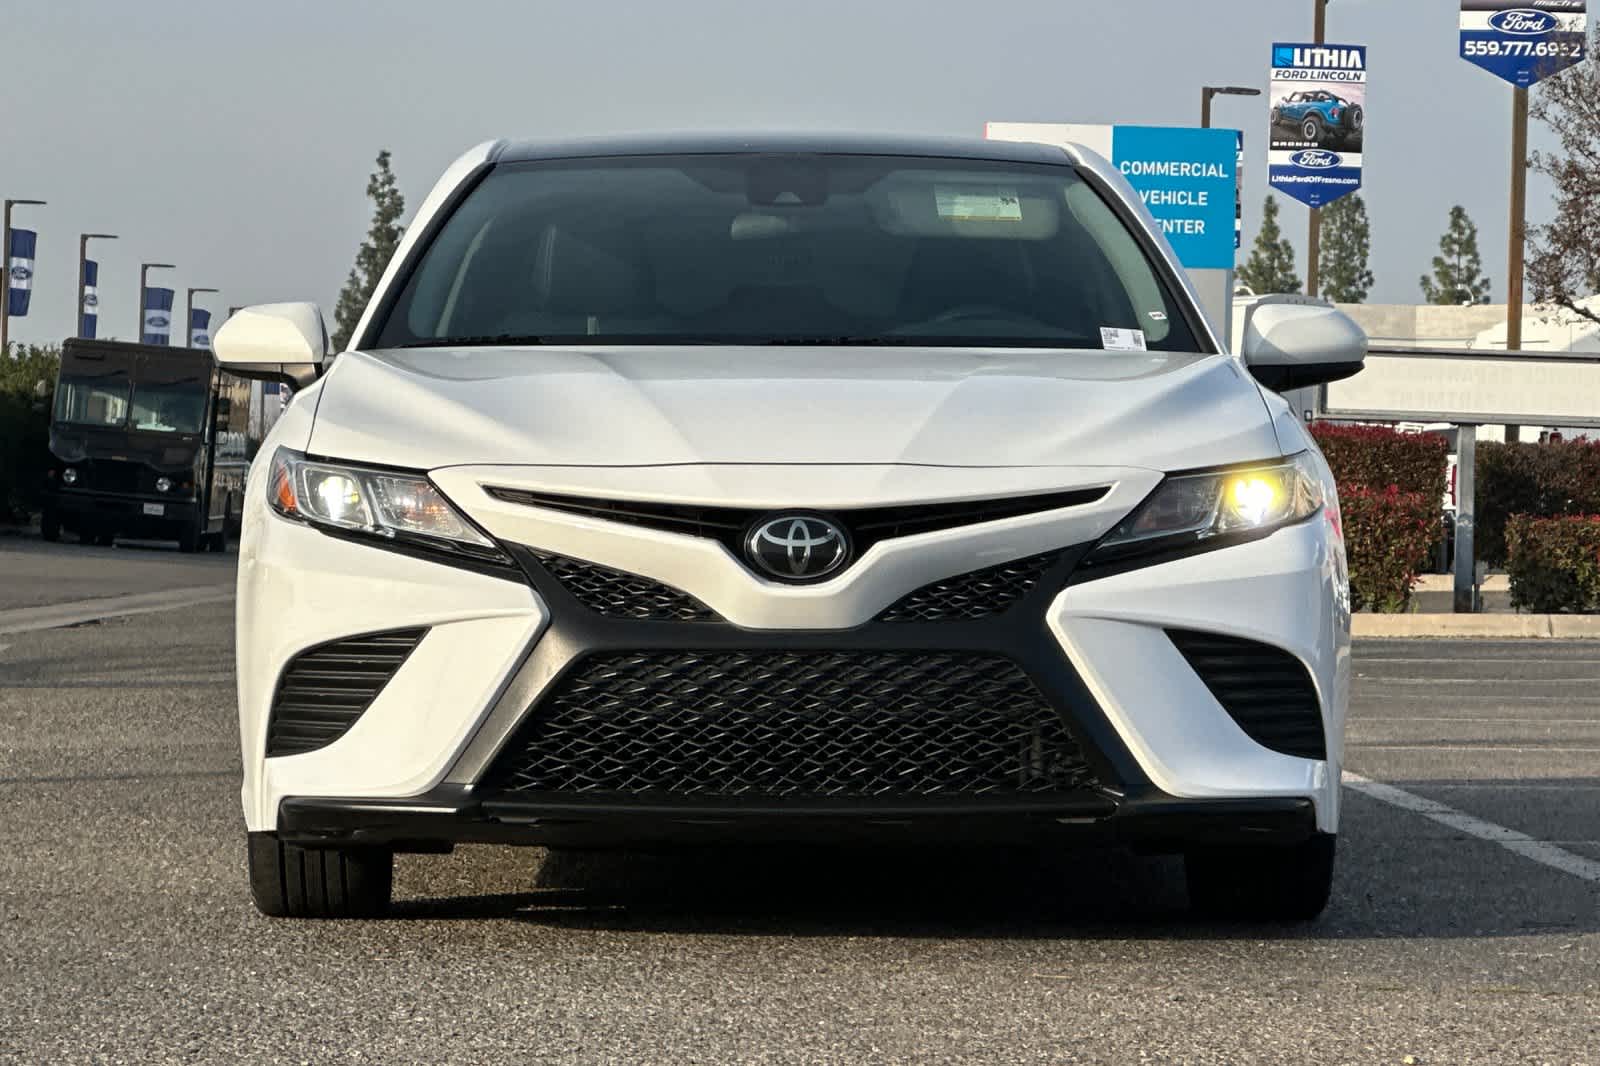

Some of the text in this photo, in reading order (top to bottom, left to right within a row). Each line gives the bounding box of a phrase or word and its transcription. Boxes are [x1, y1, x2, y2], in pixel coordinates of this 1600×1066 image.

[1501, 11, 1546, 31] Ford
[1293, 47, 1363, 68] LITHIA
[1275, 69, 1362, 81] FORD LINCOLN
[1299, 151, 1333, 167] Ford
[1120, 160, 1229, 178] COMMERCIAL
[1139, 189, 1209, 206] VEHICLE
[1154, 218, 1206, 235] NTER
